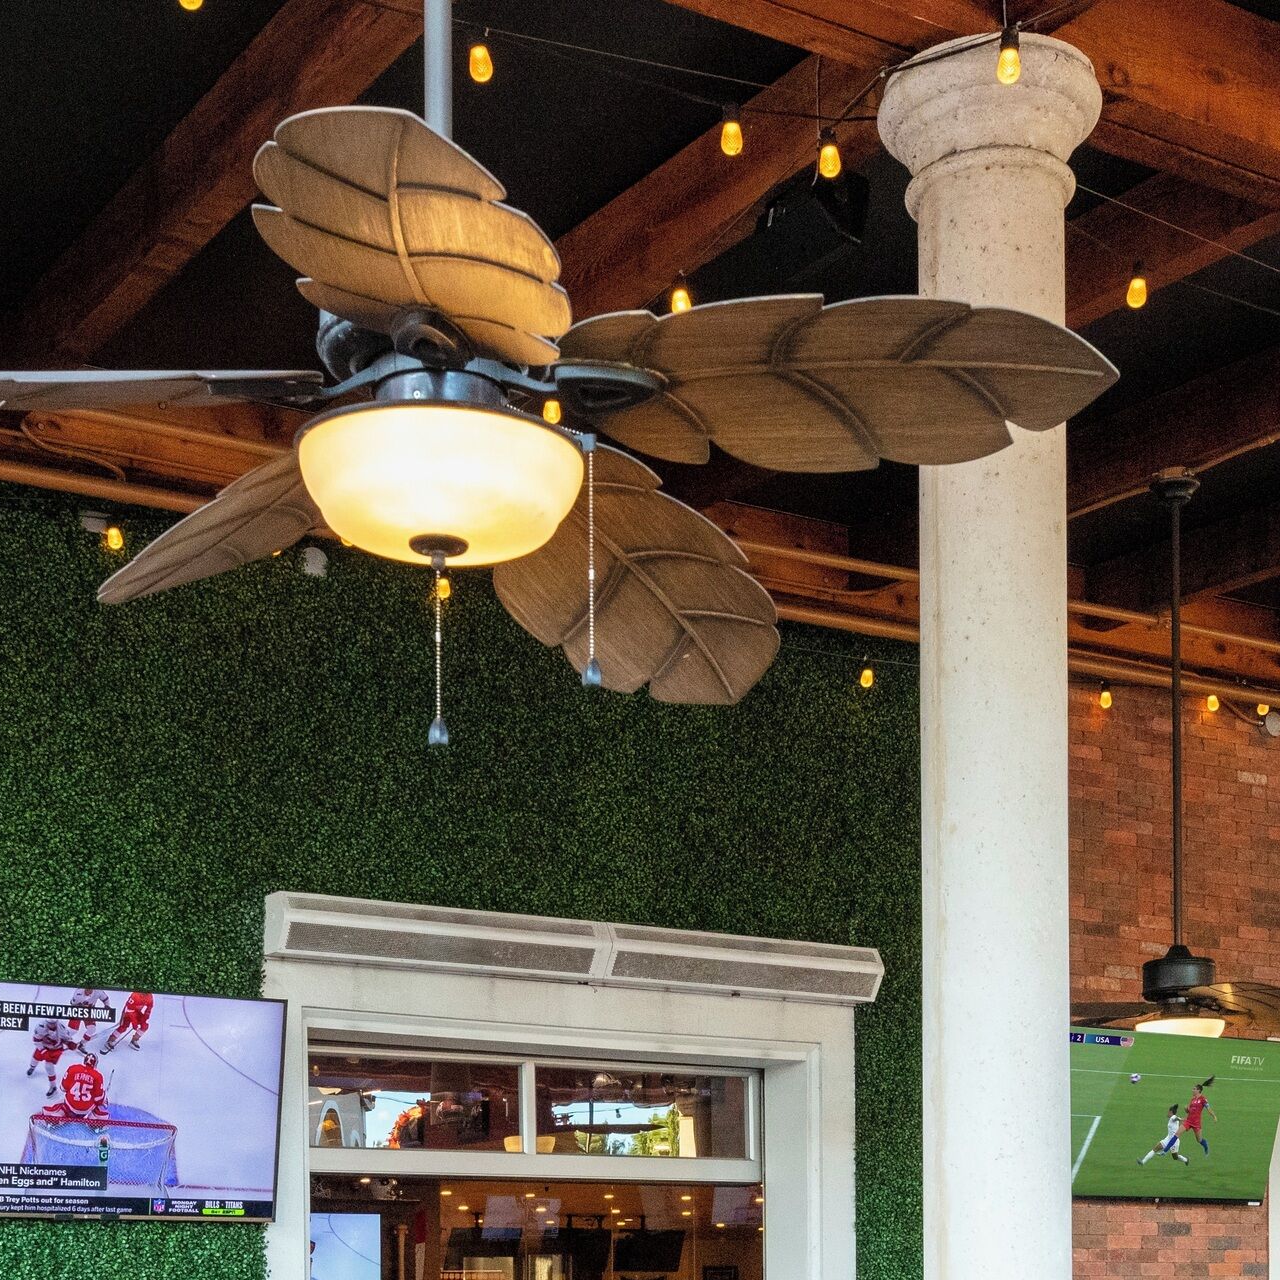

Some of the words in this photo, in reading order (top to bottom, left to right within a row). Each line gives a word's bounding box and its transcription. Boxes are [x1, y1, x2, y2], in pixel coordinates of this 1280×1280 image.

[3, 1003, 26, 1014] BEEN
[27, 1004, 34, 1015] A
[35, 1005, 54, 1016] FEW
[56, 1007, 89, 1018] PLACES
[90, 1009, 112, 1020] NOW.
[1095, 1036, 1110, 1044] USA
[1231, 1056, 1251, 1064] FIFA
[1253, 1056, 1264, 1066] TV
[70, 1082, 94, 1102] 45
[20, 1166, 67, 1176] Nicknames
[11, 1177, 35, 1187] Eggs
[60, 1178, 101, 1187] Hamilton
[225, 1201, 243, 1209] TITANS
